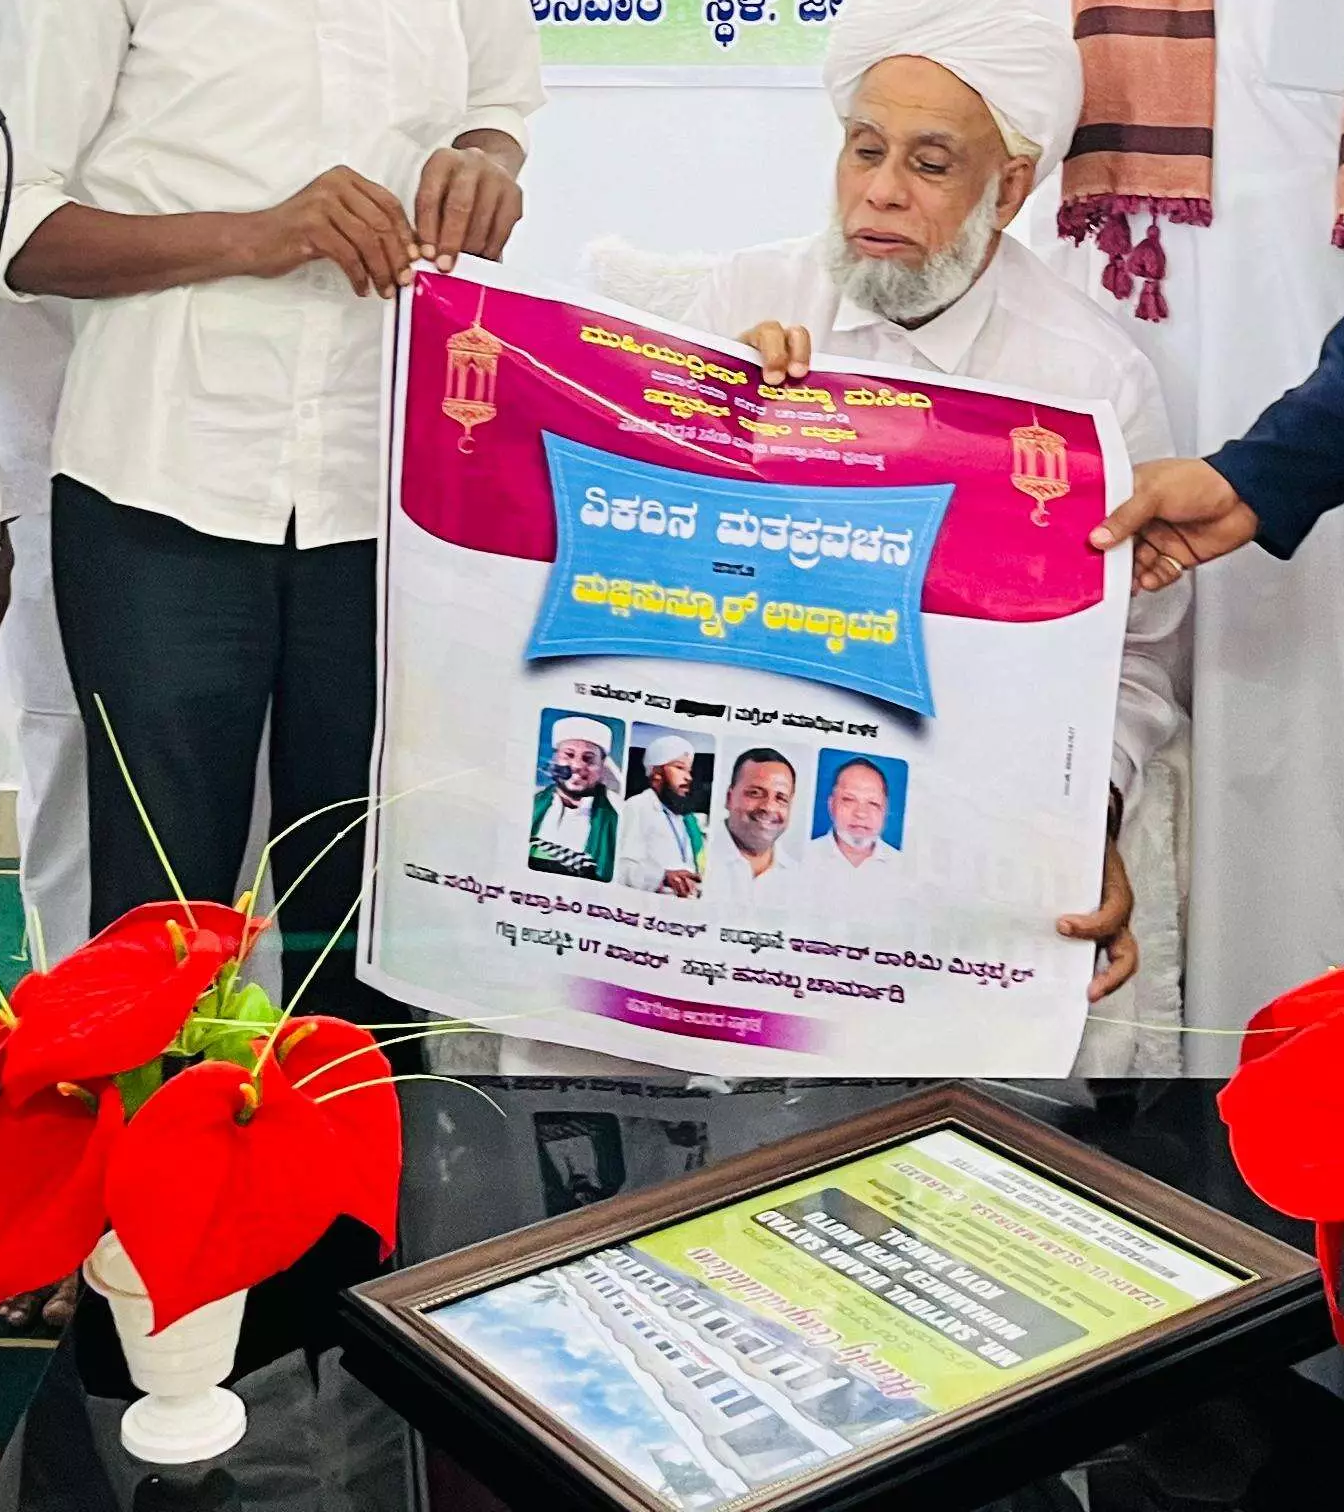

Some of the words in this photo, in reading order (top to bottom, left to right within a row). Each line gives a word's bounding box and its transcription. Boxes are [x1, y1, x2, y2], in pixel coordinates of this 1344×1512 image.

[581, 487, 699, 539] ಏಕದಿನ
[716, 509, 912, 569] ಮತಪ್ರವಚನ
[579, 938, 601, 953] UT
[753, 1209, 830, 1250] SAYYAD
[800, 1210, 866, 1244] MUTU
[815, 1246, 892, 1288] ULAMA
[853, 1241, 914, 1273] JIFRI
[873, 1227, 956, 1269] TANGAL
[944, 1266, 1008, 1299] KOYA
[879, 1284, 981, 1340] SAYYIDUL
[900, 1269, 1029, 1340] MUHAMMED
[973, 1337, 1024, 1366] MR.
